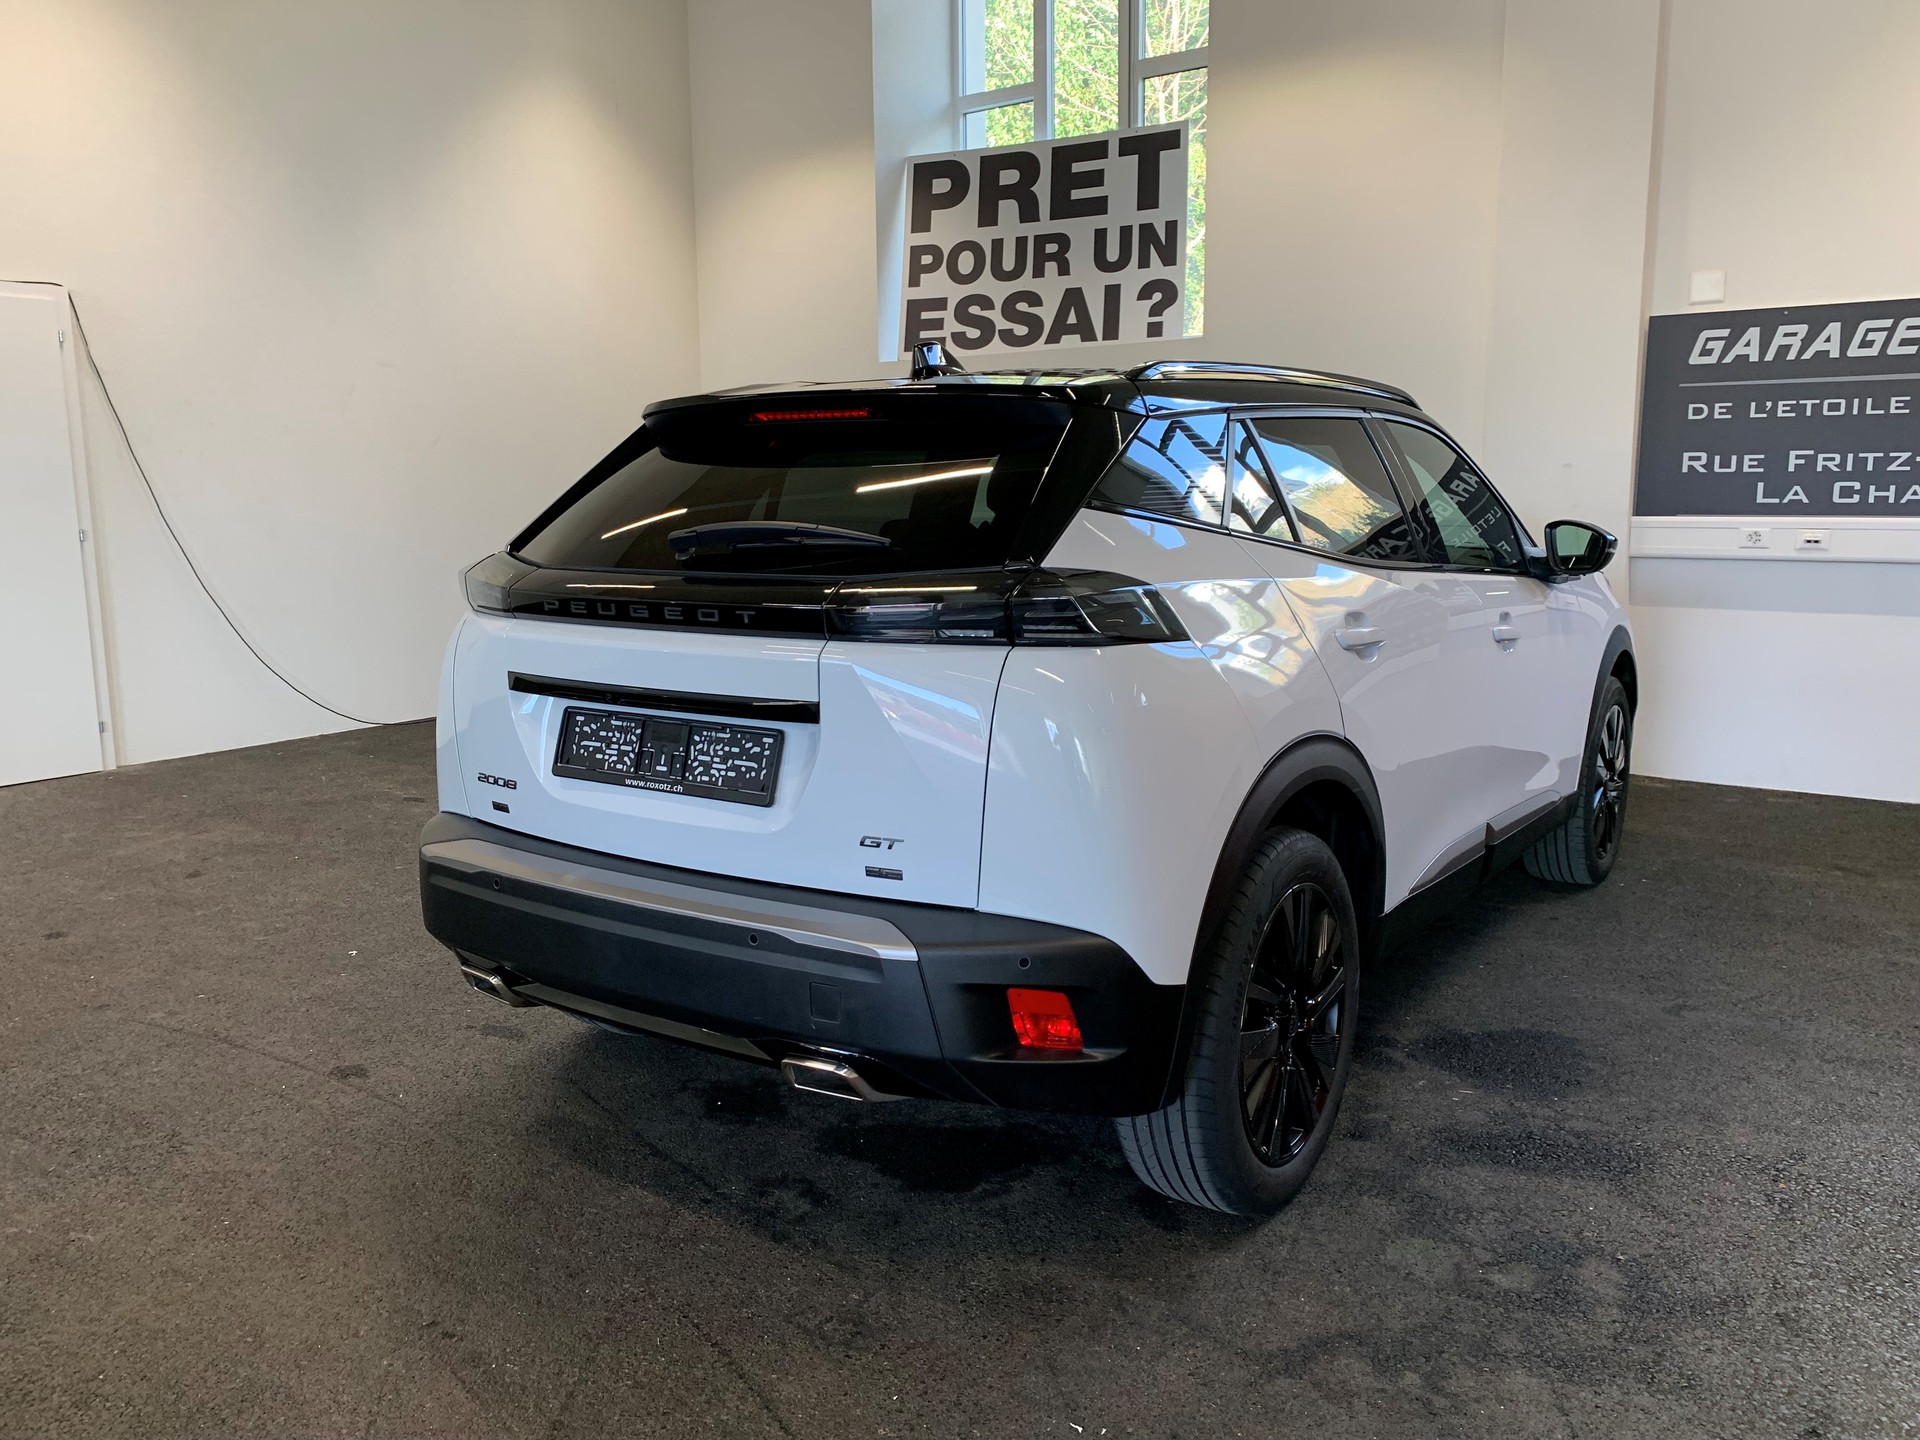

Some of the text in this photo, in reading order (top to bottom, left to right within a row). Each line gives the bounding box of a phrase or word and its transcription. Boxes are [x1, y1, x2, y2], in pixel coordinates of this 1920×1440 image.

[911, 129, 1181, 234] PRET
[908, 219, 1179, 288] POUR UN
[904, 283, 1122, 353] ESSAI
[1688, 317, 1920, 366] GARAGE
[1687, 402, 1733, 420] DE
[1756, 482, 1809, 504] LA
[543, 601, 756, 624] PEUGEOT
[477, 772, 518, 790] 2008
[624, 777, 683, 794] www.roxotz.ch
[859, 835, 905, 850] GT
